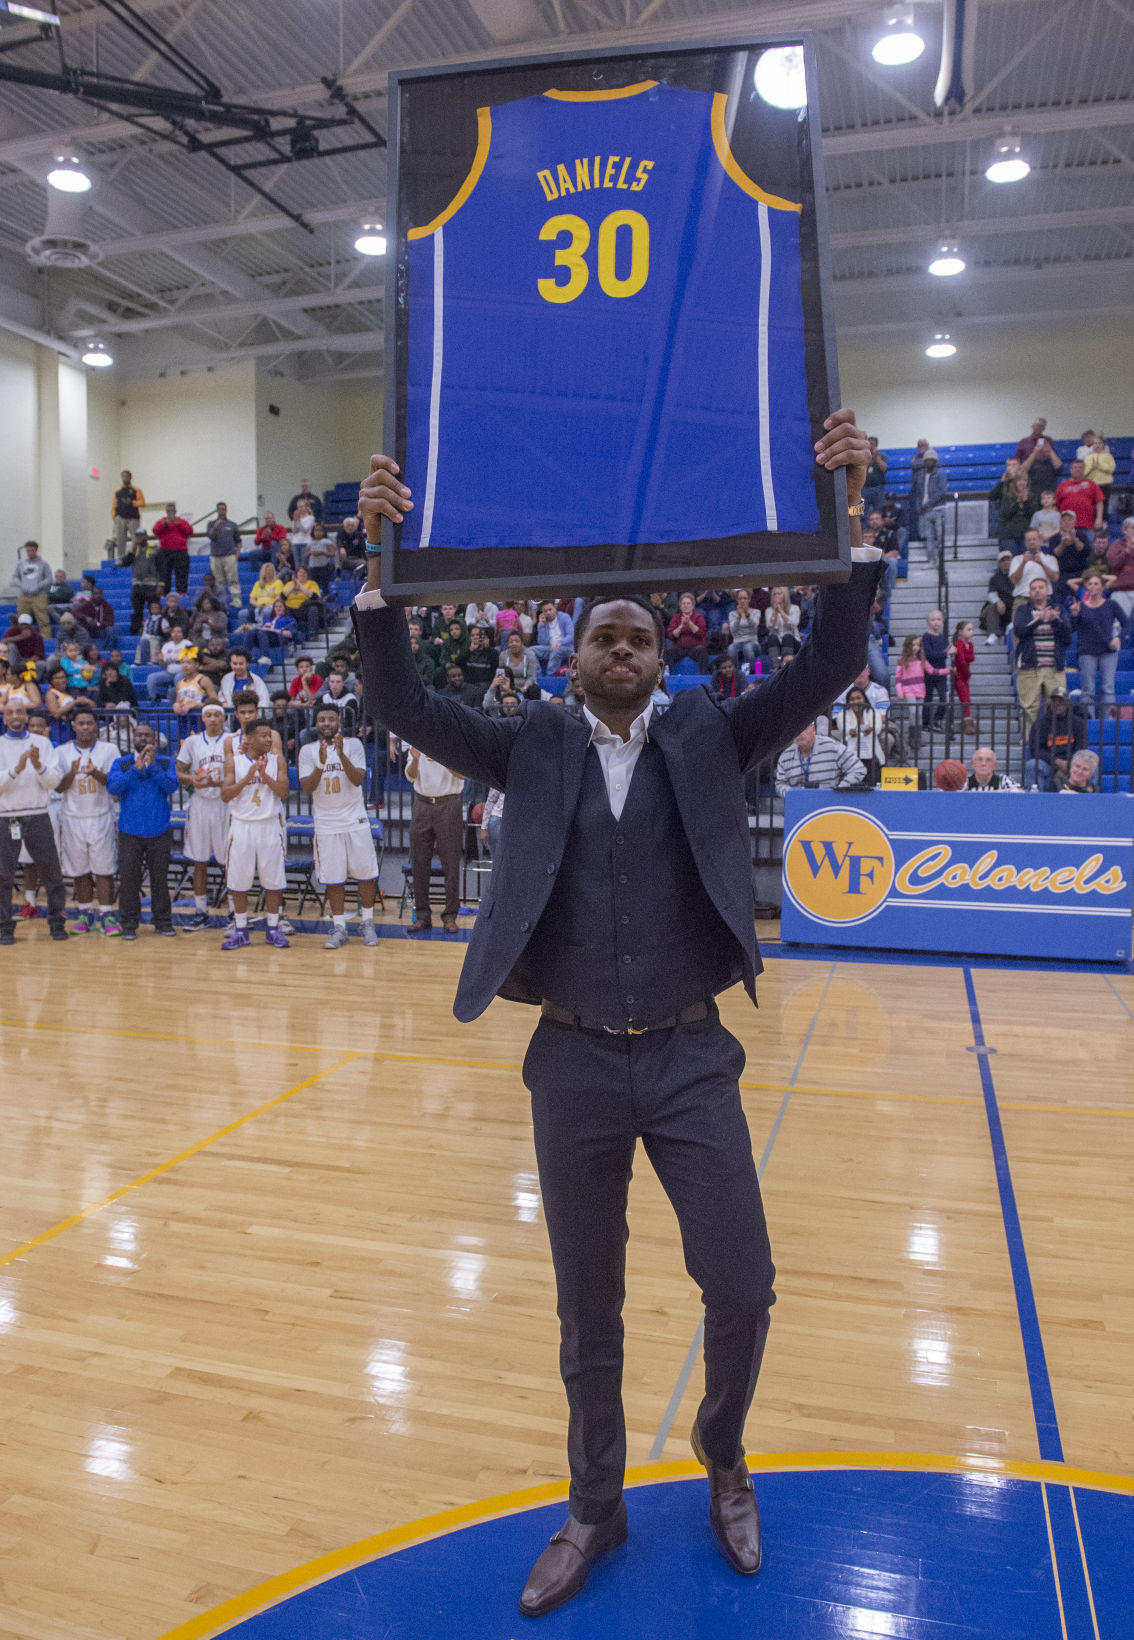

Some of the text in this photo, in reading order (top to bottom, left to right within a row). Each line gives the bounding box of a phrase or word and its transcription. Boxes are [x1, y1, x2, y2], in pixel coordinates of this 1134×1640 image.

[536, 156, 655, 201] DANIELS
[537, 209, 650, 304] 30
[251, 788, 261, 807] 4
[323, 775, 342, 795] 10
[798, 840, 885, 895] WF
[895, 844, 1127, 896] Colonels
